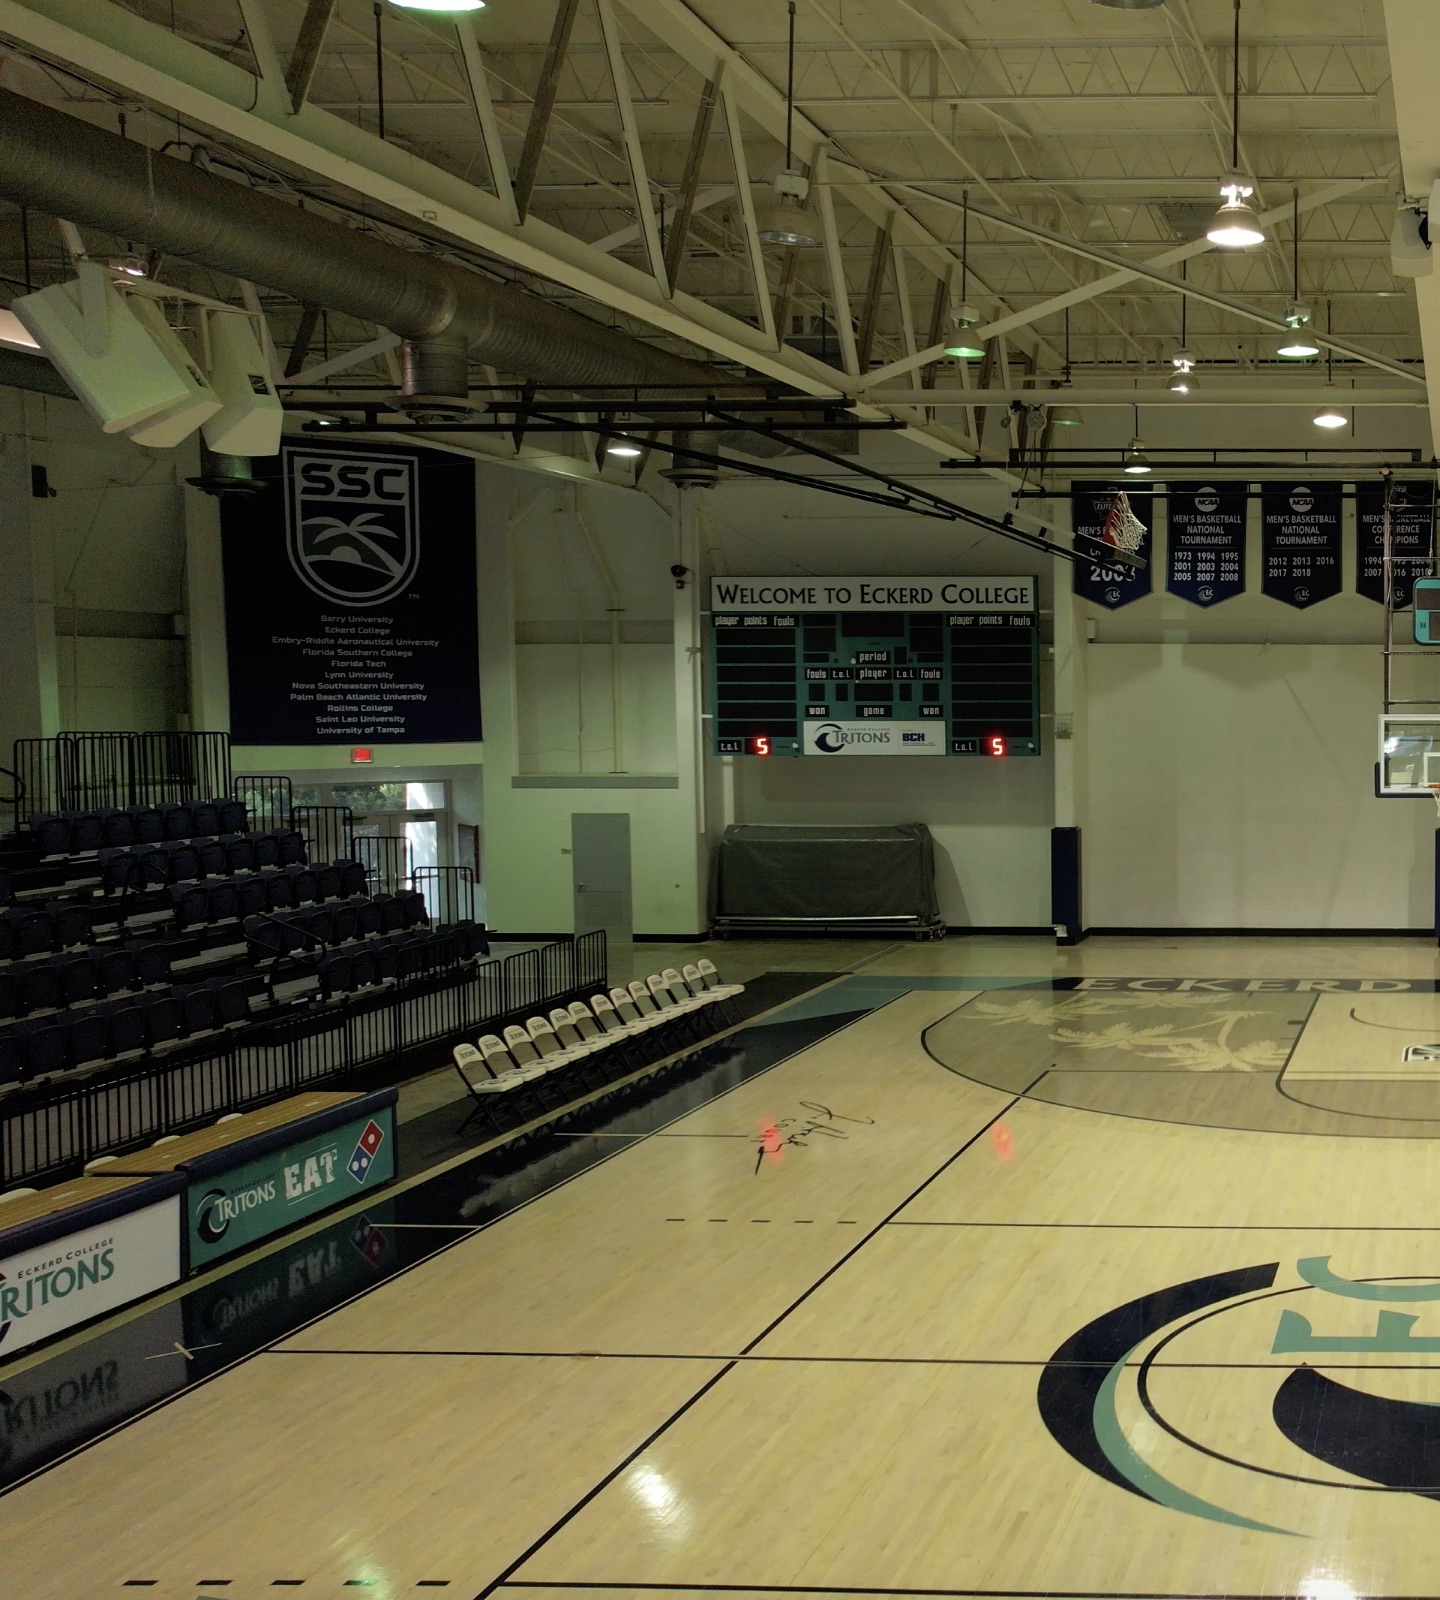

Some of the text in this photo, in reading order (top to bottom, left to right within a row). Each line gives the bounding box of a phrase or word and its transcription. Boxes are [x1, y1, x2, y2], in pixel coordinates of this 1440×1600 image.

[301, 463, 405, 500] SSC
[1173, 515, 1241, 523] MEN'S BASKETBALL
[1266, 515, 1336, 523] MEN'S BASKETBALL
[1187, 526, 1224, 534] NATIONAL
[1282, 526, 1320, 534] NATIONAL
[1181, 536, 1232, 544] TOURNAMENT
[1275, 536, 1327, 544] TOURNAMENT
[1174, 552, 1238, 560] 1973 1994 1995
[1269, 557, 1334, 565] 2012 2013 2016
[1364, 557, 1382, 565] 1994
[1174, 562, 1238, 571] 2001 2003 2004
[1174, 573, 1238, 581] 2005 2007 2008
[1269, 569, 1311, 577] 2017 2018
[1364, 569, 1382, 577] 2007
[716, 584, 1029, 604] WELCOME TO ECKERD COLLEGE
[321, 615, 393, 625] Barry University
[715, 616, 794, 626] player points fouls
[950, 615, 1031, 626] player points fouls
[325, 626, 390, 635] Eckerd College
[272, 636, 439, 648] Embry-Riddle Aeronautical University
[381, 650, 413, 658] College
[860, 652, 887, 662] period
[325, 671, 394, 680] Lynn University
[807, 669, 826, 679] fouls
[860, 669, 887, 679] player
[921, 669, 940, 679] fouls
[292, 682, 424, 690] Nova Southeastern University
[290, 693, 314, 701] Palm
[361, 705, 393, 713] College
[809, 707, 825, 715] won
[864, 707, 884, 717] game
[923, 707, 939, 715] won
[360, 715, 405, 724] University
[317, 727, 362, 735] University
[376, 726, 405, 735] Tampa
[833, 731, 890, 744] TRITONS
[902, 733, 925, 742] BCH
[757, 738, 768, 755] 5
[992, 738, 1003, 755] 5
[1073, 977, 1411, 992] ECKERD
[284, 1149, 338, 1200] EAT
[214, 1181, 276, 1221] TRITONS
[18, 1238, 114, 1279] ECKERD COLLEGE
[0, 1248, 115, 1321] RITONS
